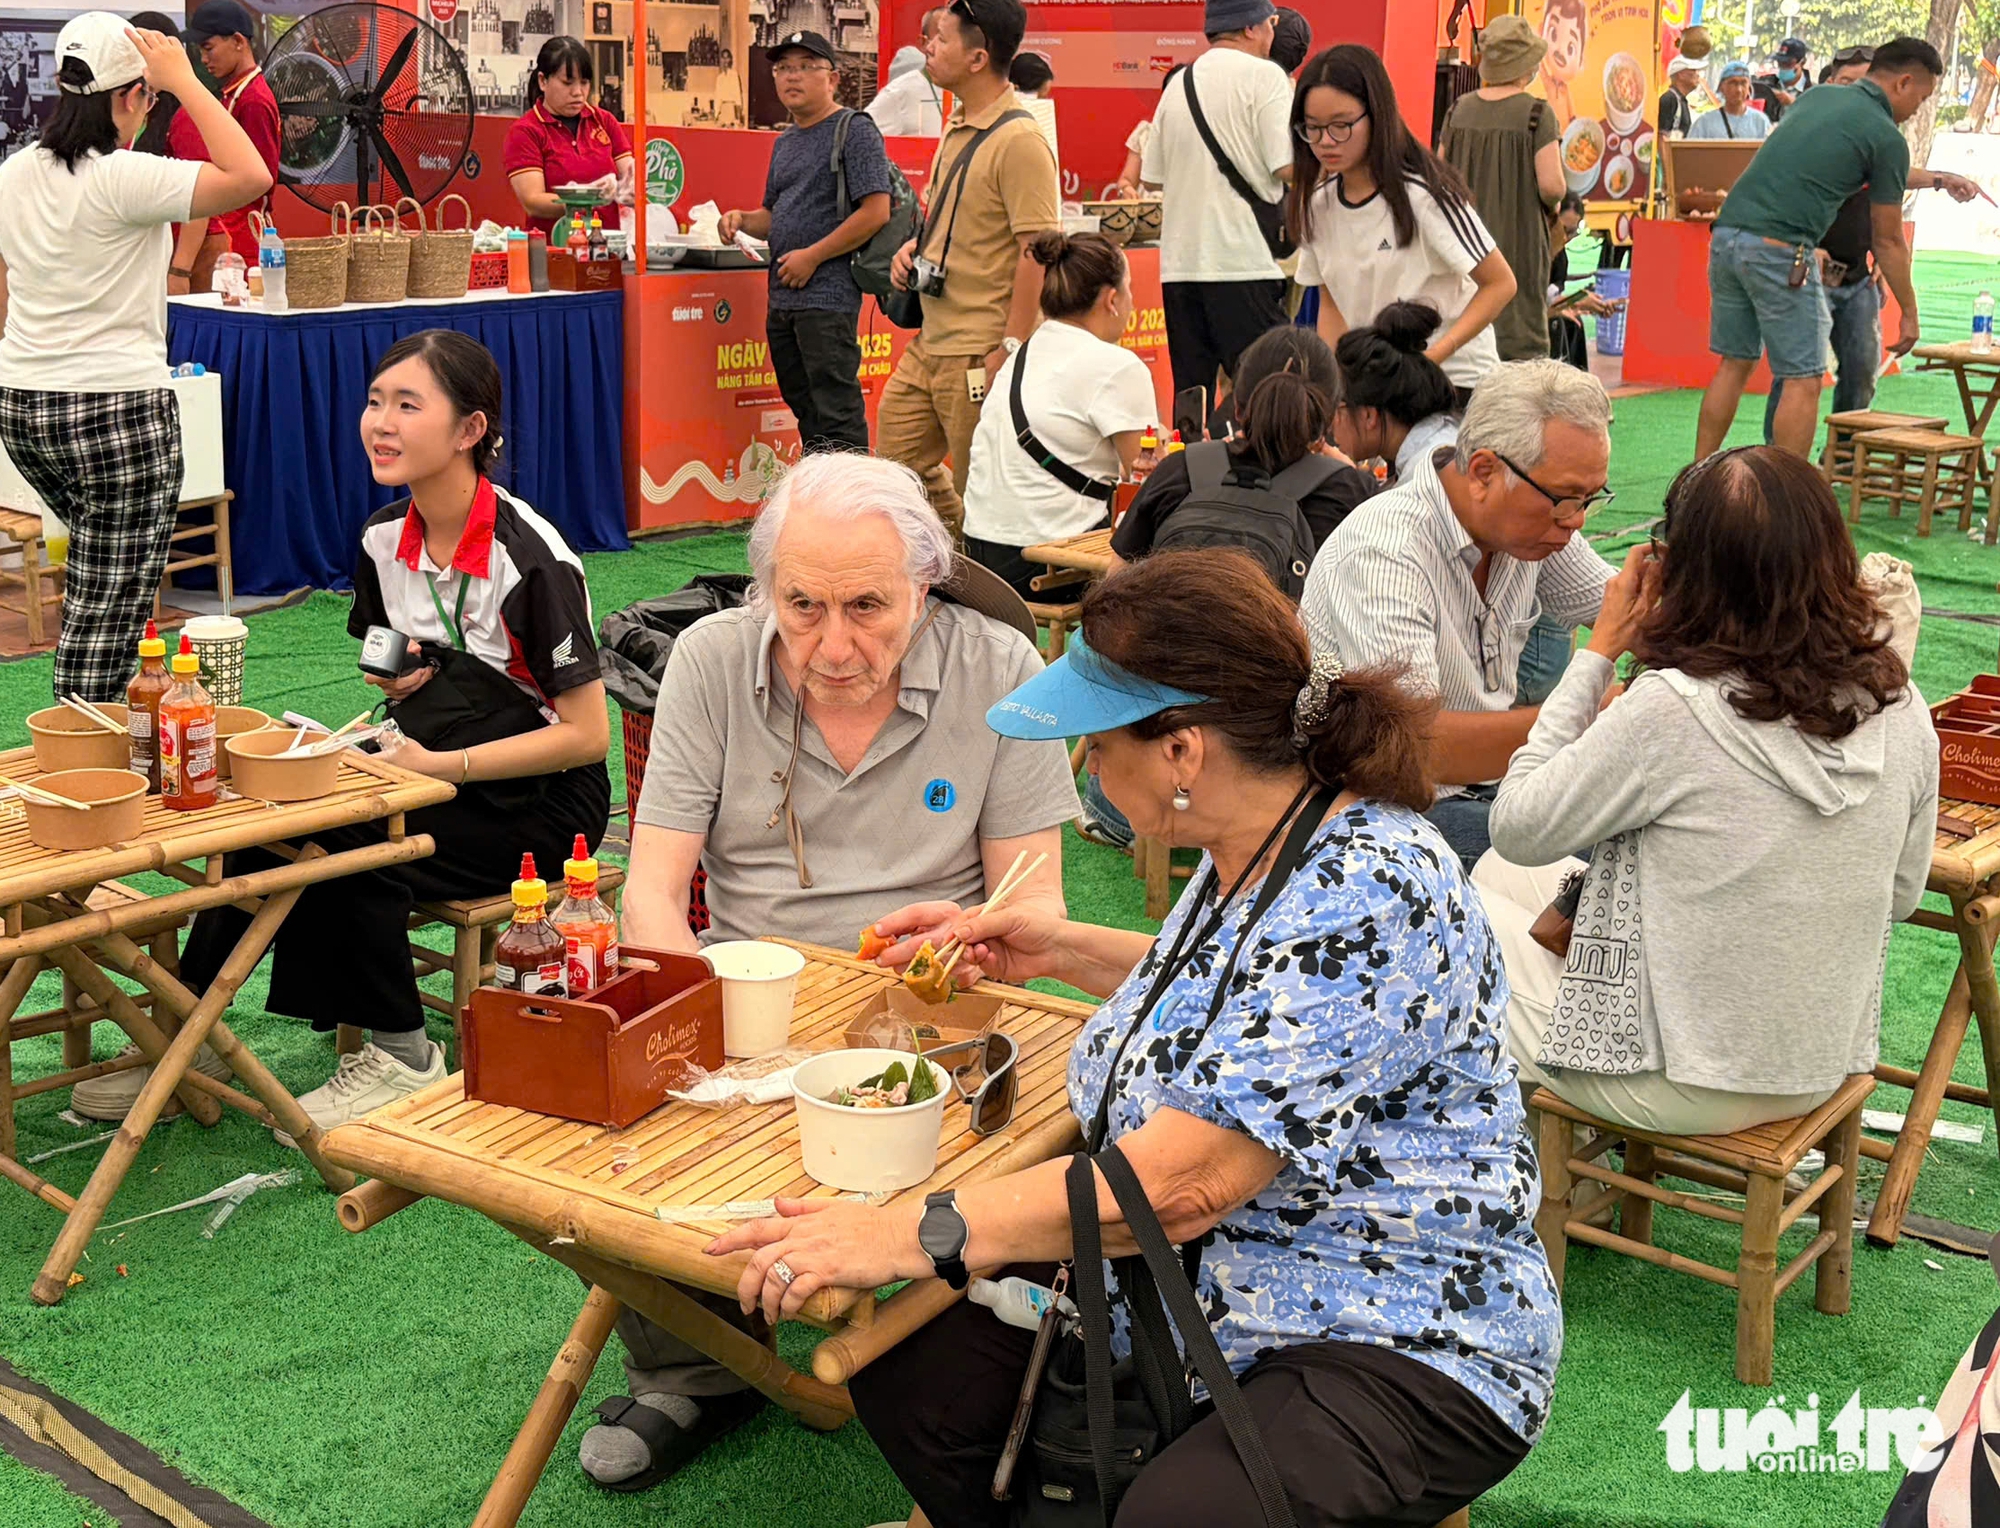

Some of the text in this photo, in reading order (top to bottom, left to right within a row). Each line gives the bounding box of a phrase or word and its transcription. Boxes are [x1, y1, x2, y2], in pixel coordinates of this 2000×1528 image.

[1140, 308, 1166, 331] 202
[717, 338, 767, 370] NGÀY
[553, 655, 580, 669] HONDA
[1020, 704, 1059, 727] VALLARTA
[1942, 743, 2000, 768] Cholime
[931, 795, 945, 804] 28
[646, 1018, 698, 1061] Cholimex
